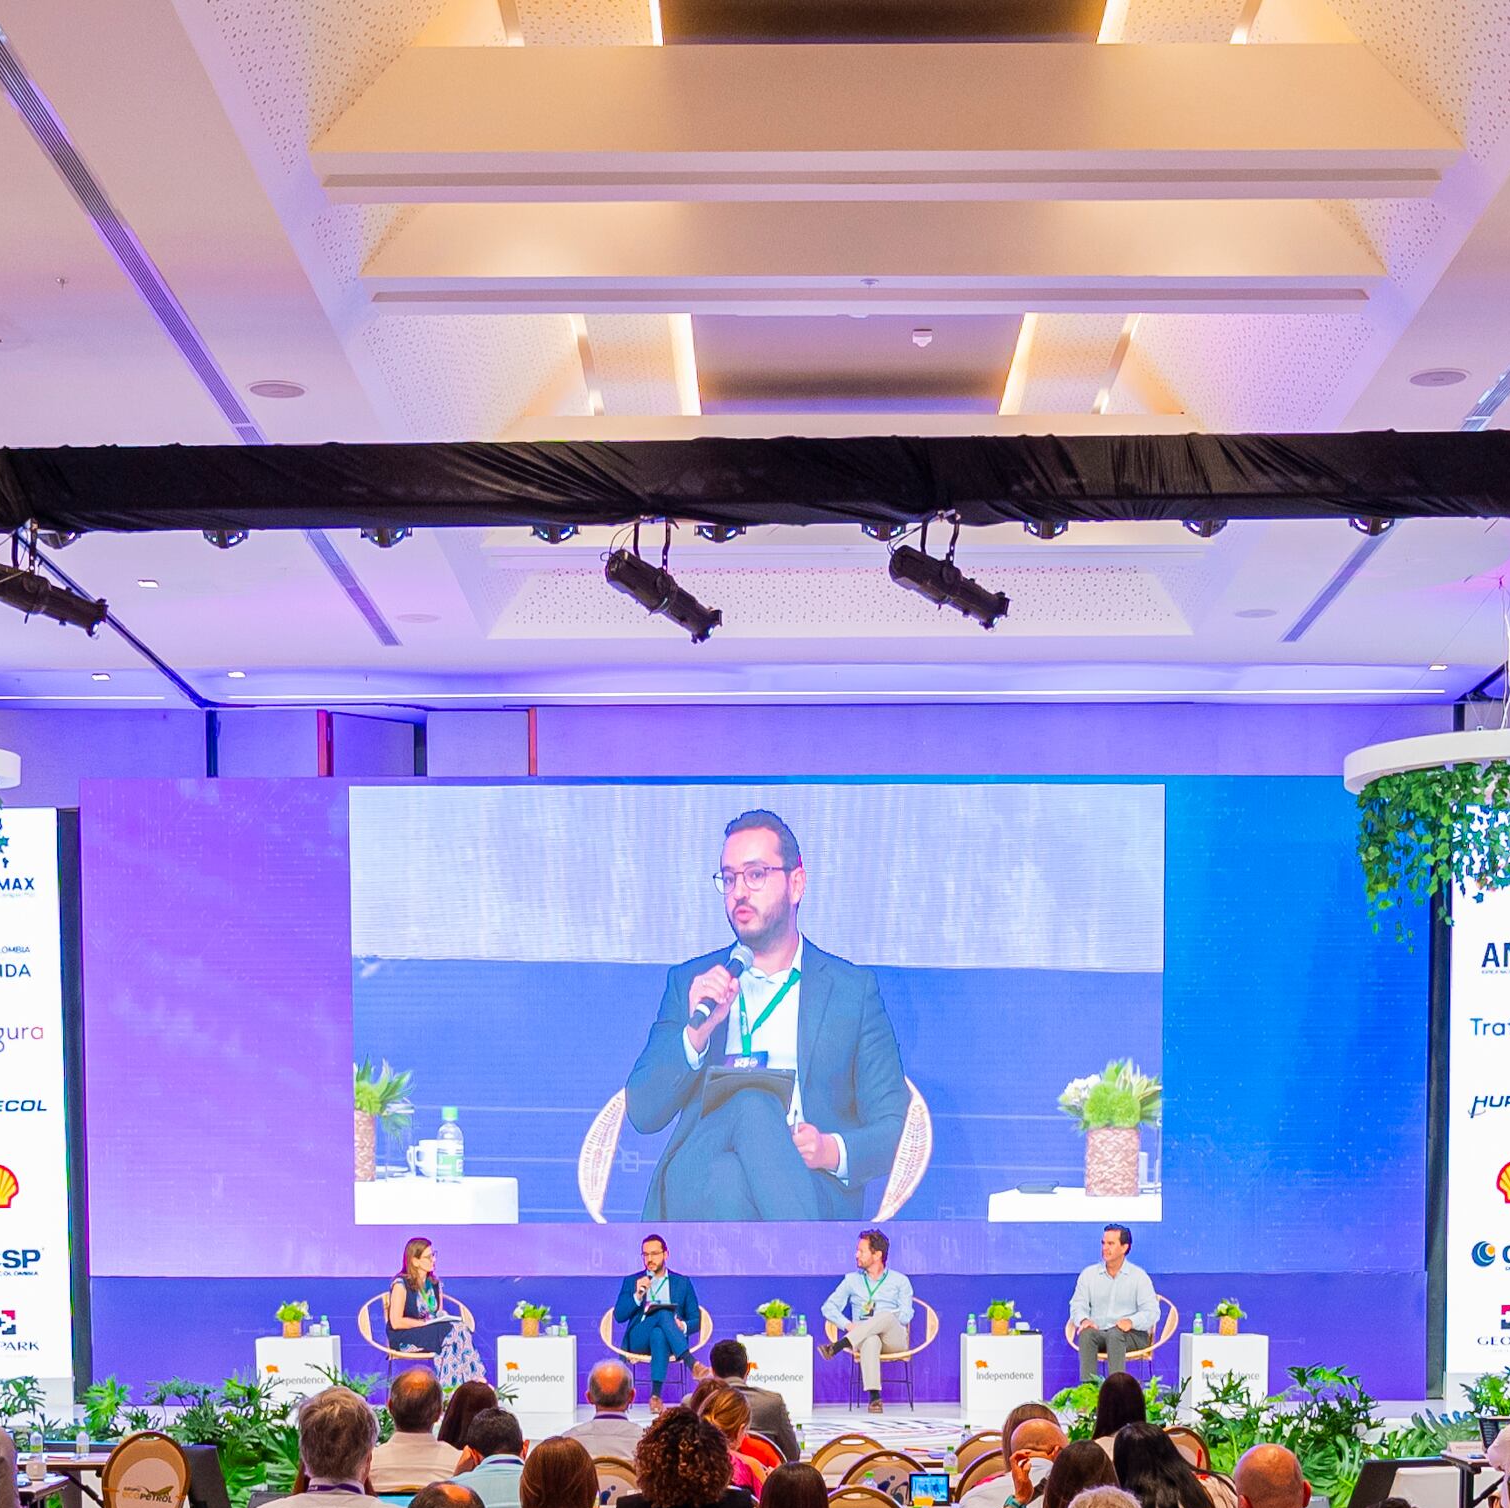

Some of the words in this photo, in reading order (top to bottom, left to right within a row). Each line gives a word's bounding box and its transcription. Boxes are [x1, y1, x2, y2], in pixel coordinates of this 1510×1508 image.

[507, 1373, 564, 1383] Independence
[749, 1373, 804, 1383] ndependence
[976, 1372, 1034, 1381] Independence
